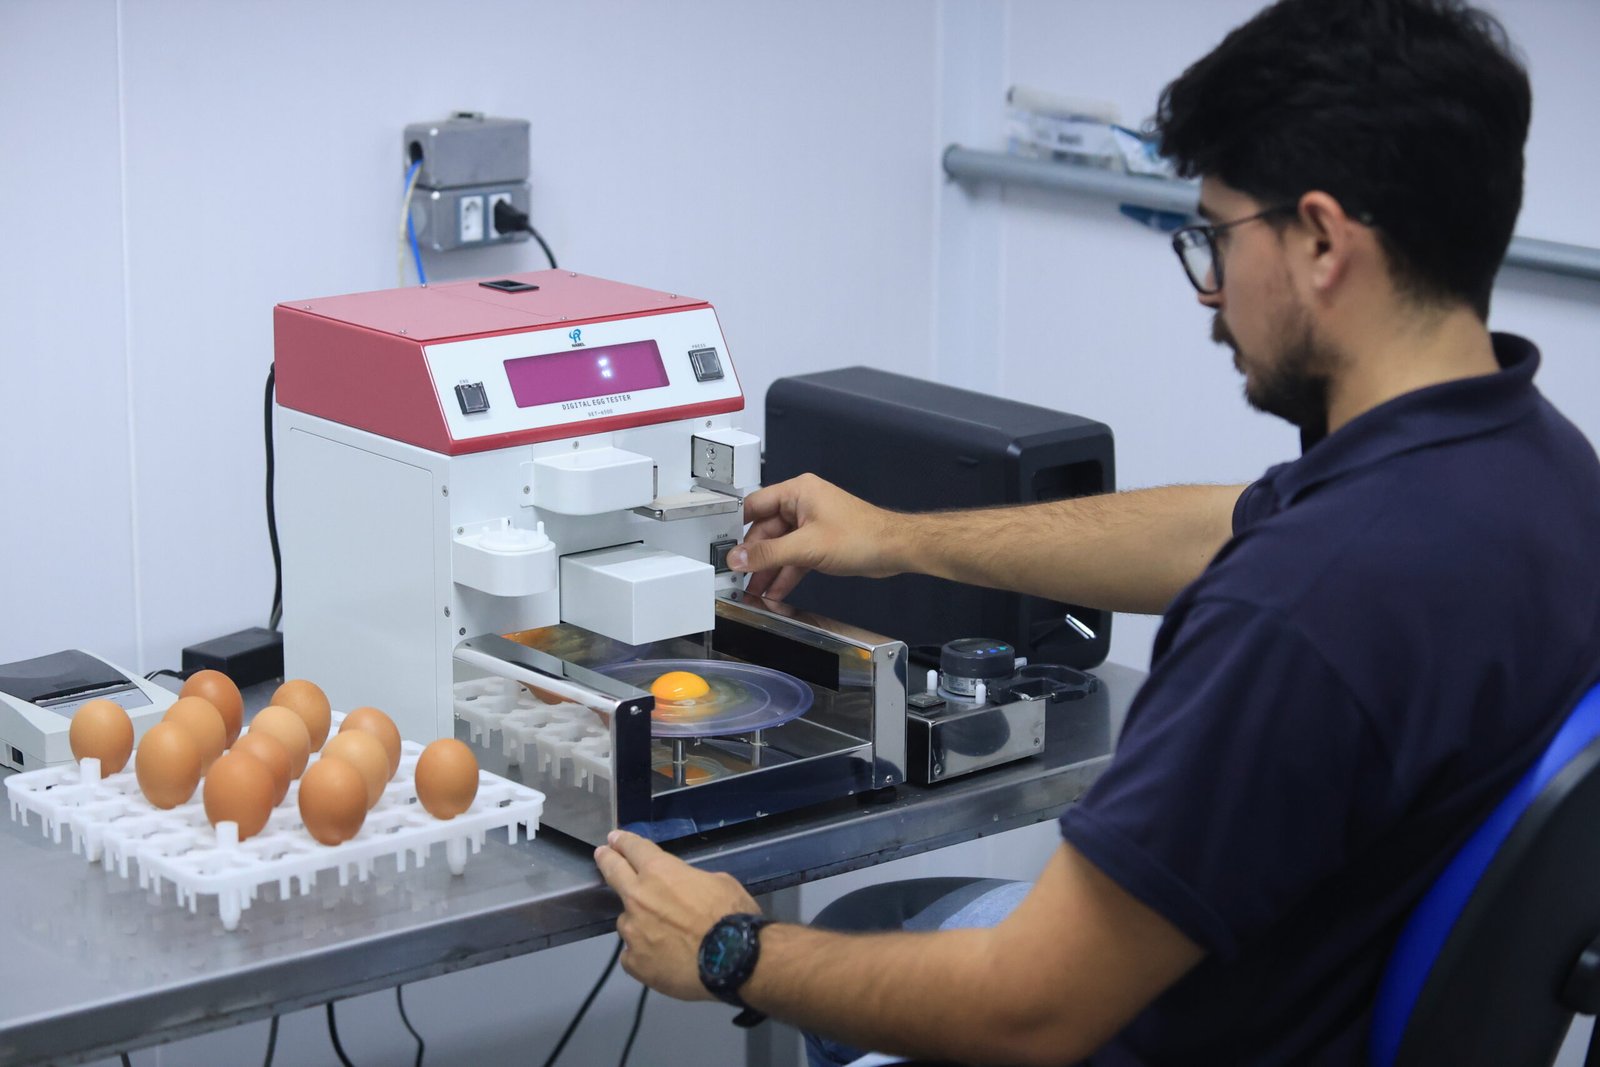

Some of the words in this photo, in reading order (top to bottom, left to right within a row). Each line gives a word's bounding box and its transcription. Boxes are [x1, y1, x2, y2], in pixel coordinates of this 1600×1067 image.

[562, 400, 591, 410] DIGITAL
[592, 398, 605, 406] EGG
[606, 394, 631, 403] TESTER
